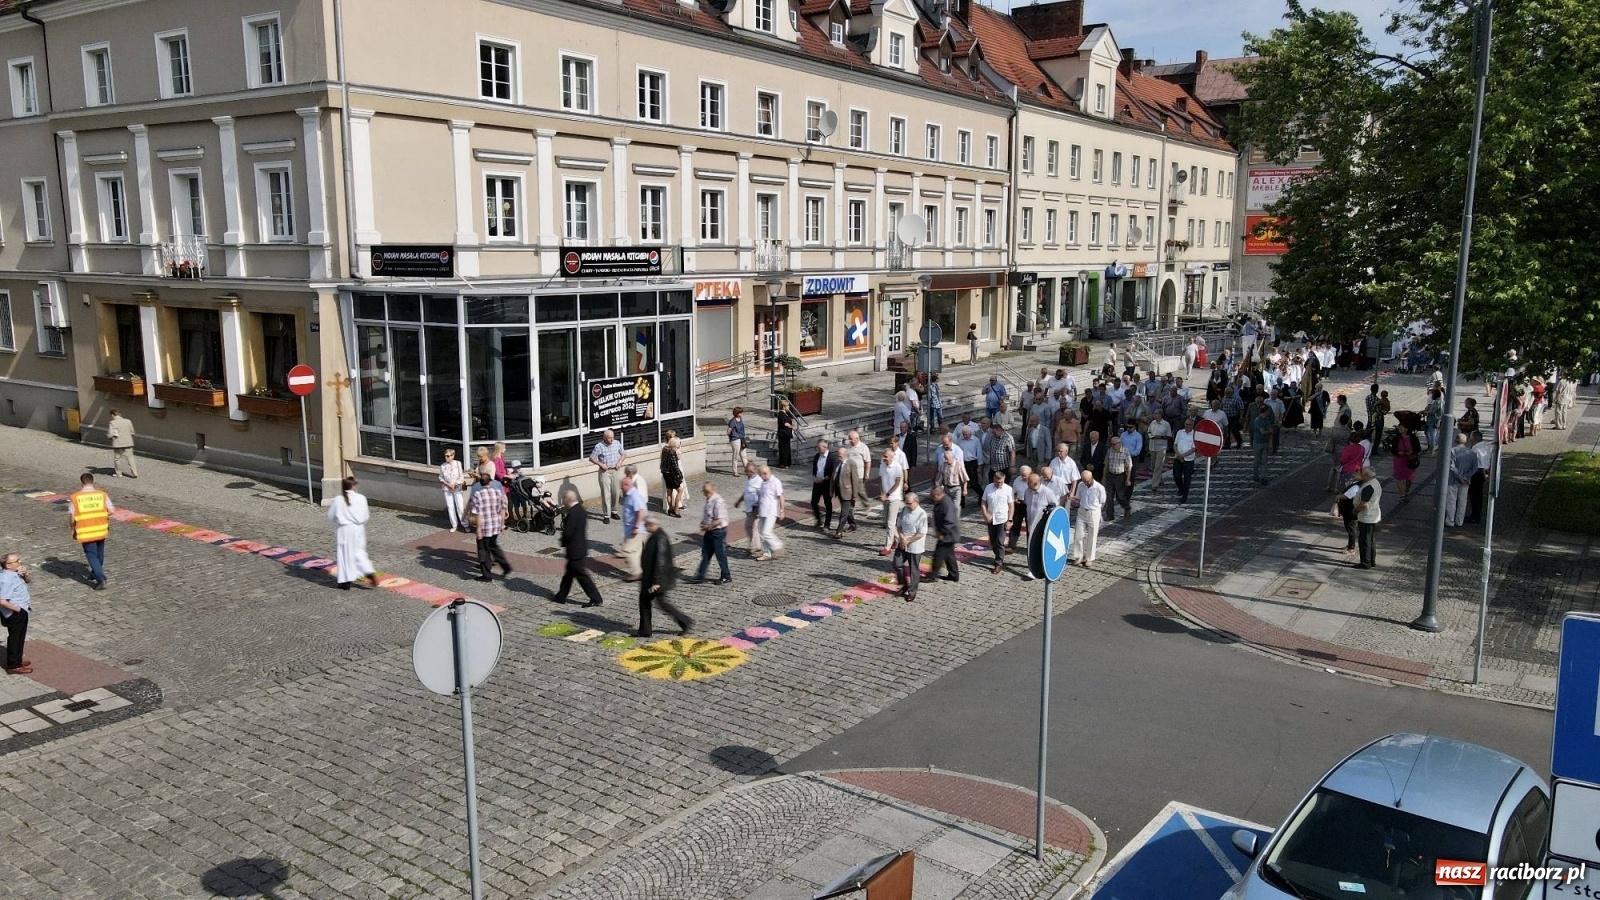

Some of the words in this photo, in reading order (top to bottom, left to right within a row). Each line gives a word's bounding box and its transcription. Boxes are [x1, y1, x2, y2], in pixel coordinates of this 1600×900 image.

[383, 252, 399, 260] INDIAN
[581, 252, 602, 261] INDIAN
[603, 252, 626, 261] MASALA
[627, 252, 649, 260] KITCHEN
[695, 281, 741, 298] PTEKA
[808, 277, 855, 293] ZDROWIT
[593, 394, 614, 407] WIELKIE
[614, 389, 636, 398] OTWARC
[600, 407, 621, 416] czerwca
